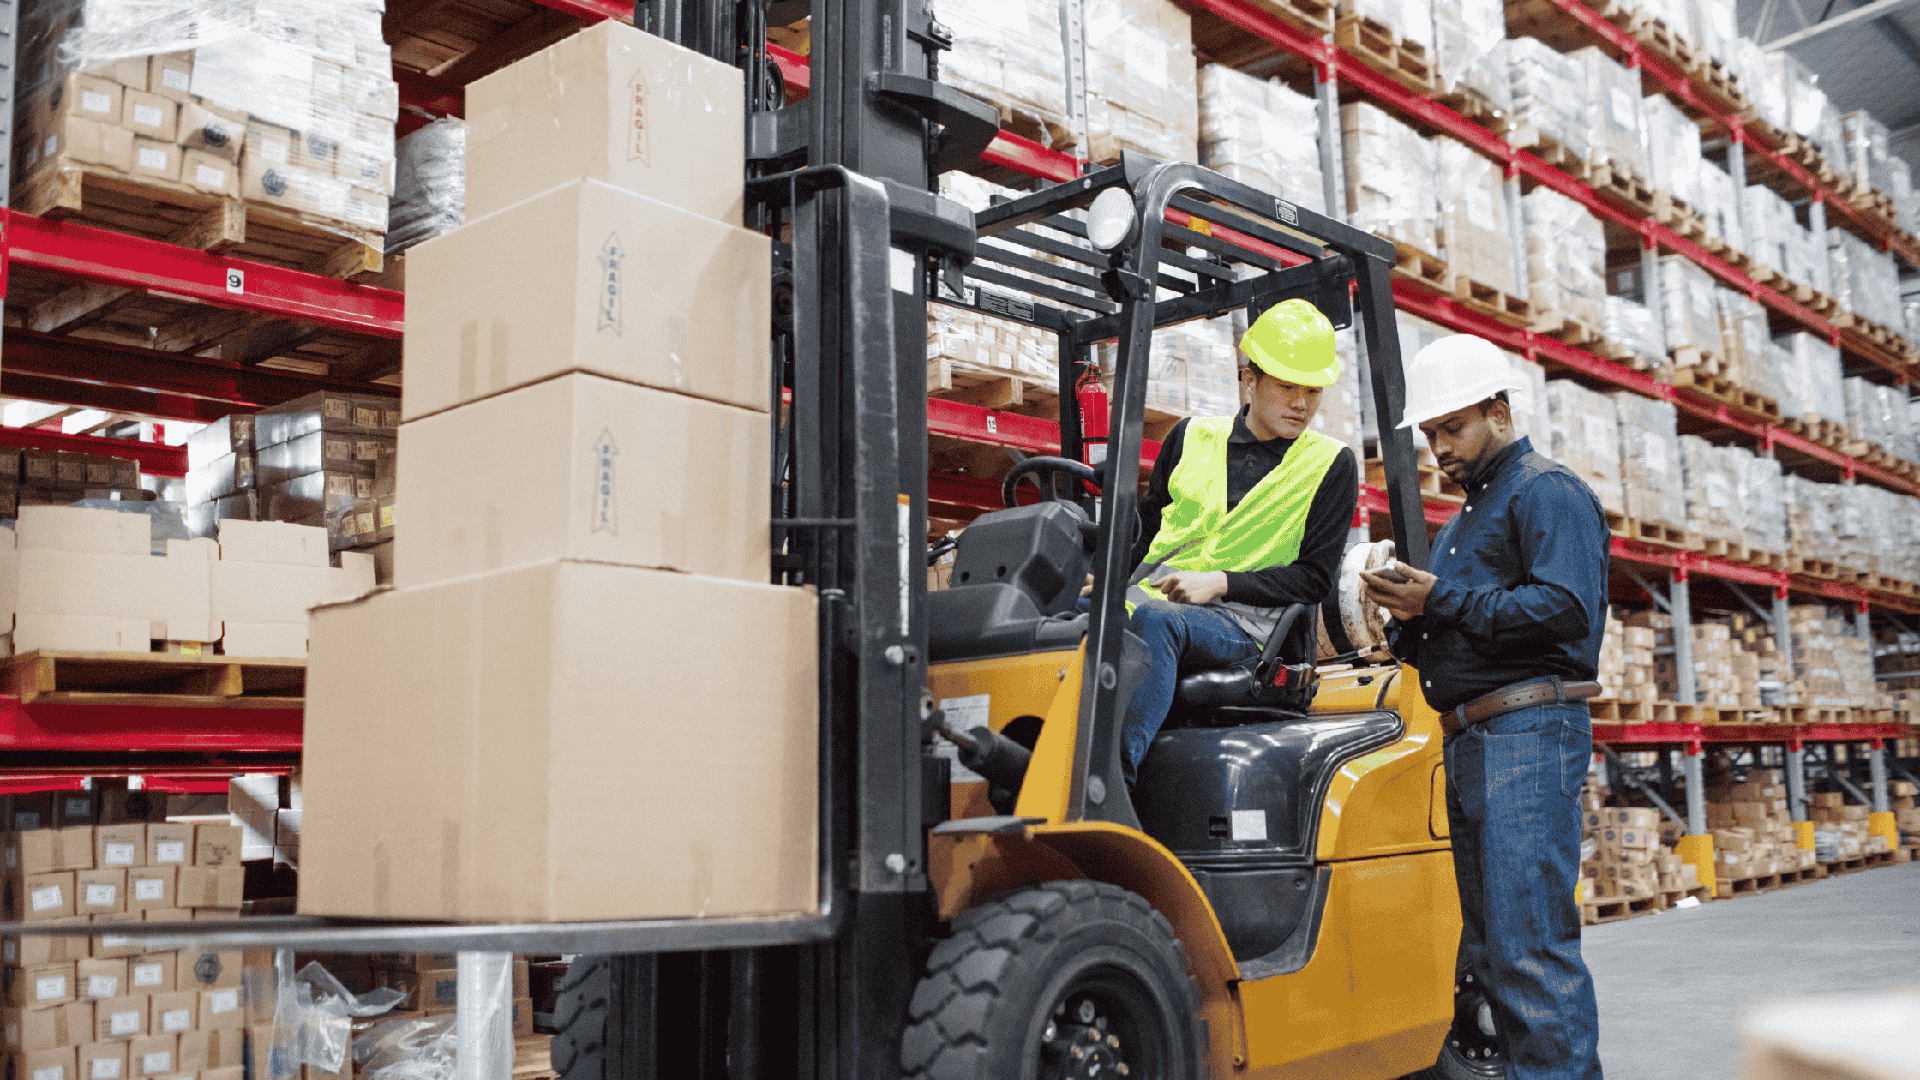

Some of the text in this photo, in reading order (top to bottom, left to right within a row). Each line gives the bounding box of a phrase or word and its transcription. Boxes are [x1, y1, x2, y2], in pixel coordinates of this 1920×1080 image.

[635, 83, 644, 154] FRAGIL
[228, 274, 242, 288] 9
[606, 246, 619, 321] FRAGIL
[600, 444, 612, 522] FRAGIL
